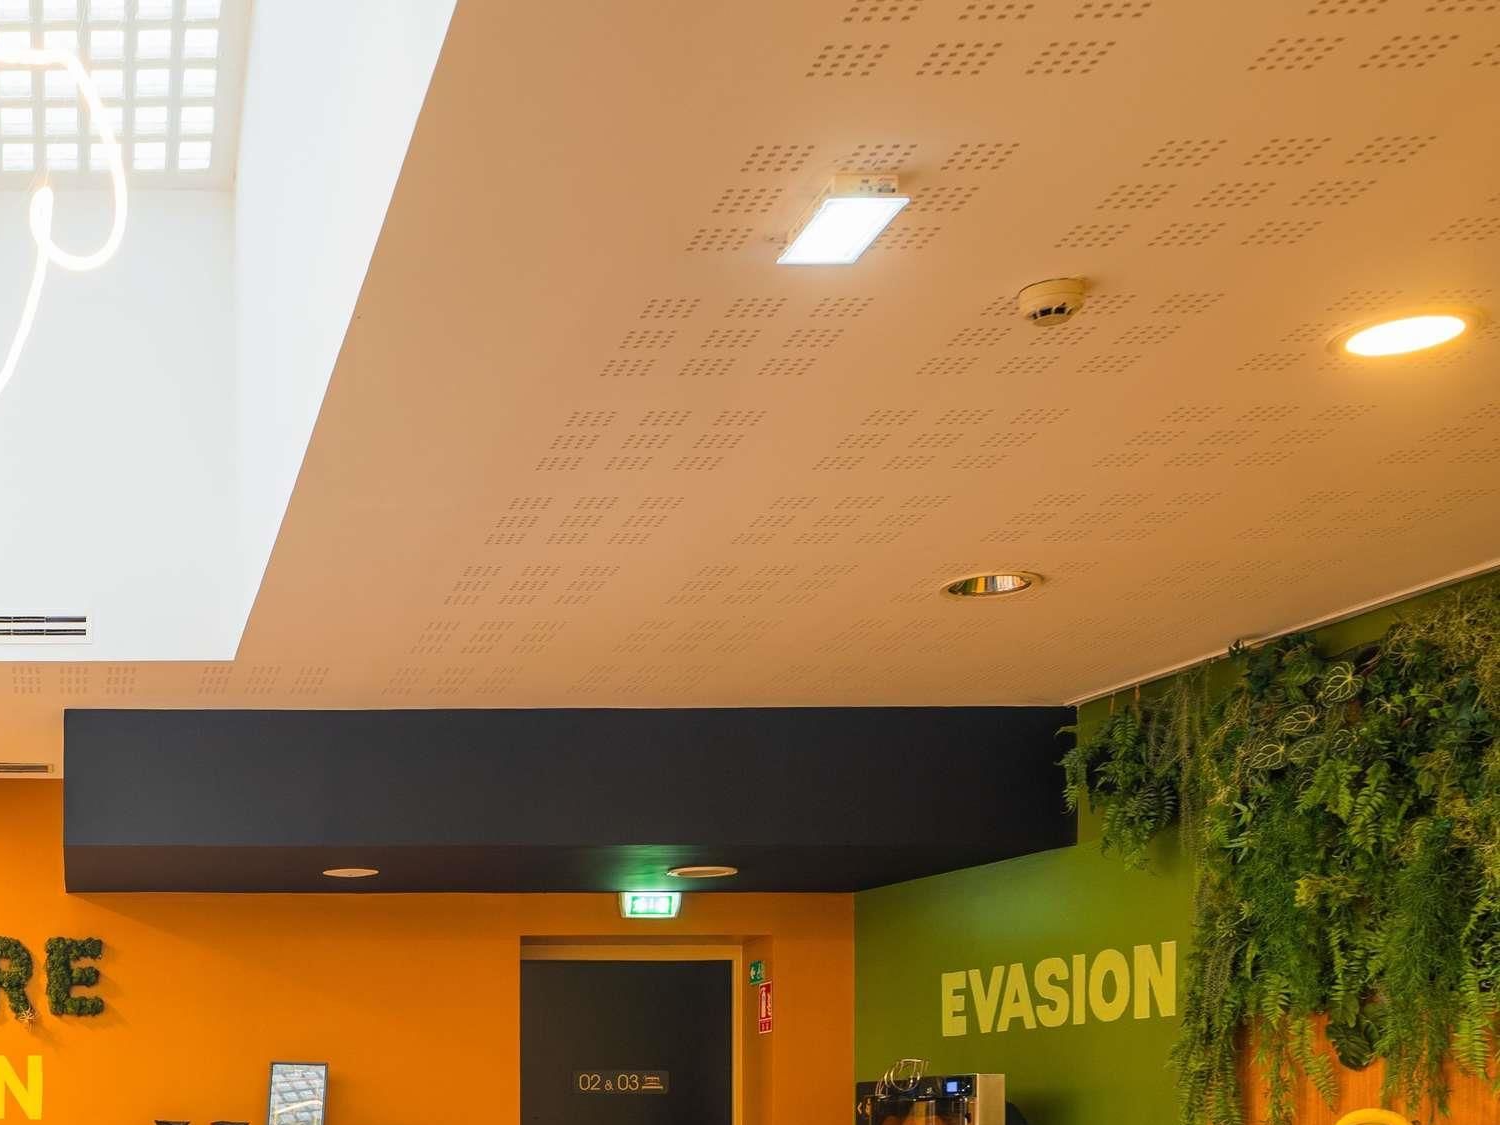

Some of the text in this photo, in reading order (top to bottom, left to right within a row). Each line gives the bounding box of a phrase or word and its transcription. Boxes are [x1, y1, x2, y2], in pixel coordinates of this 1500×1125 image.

[941, 940, 1177, 1037] EVASION
[579, 1073, 601, 1091] 02
[617, 1073, 639, 1091] 03
